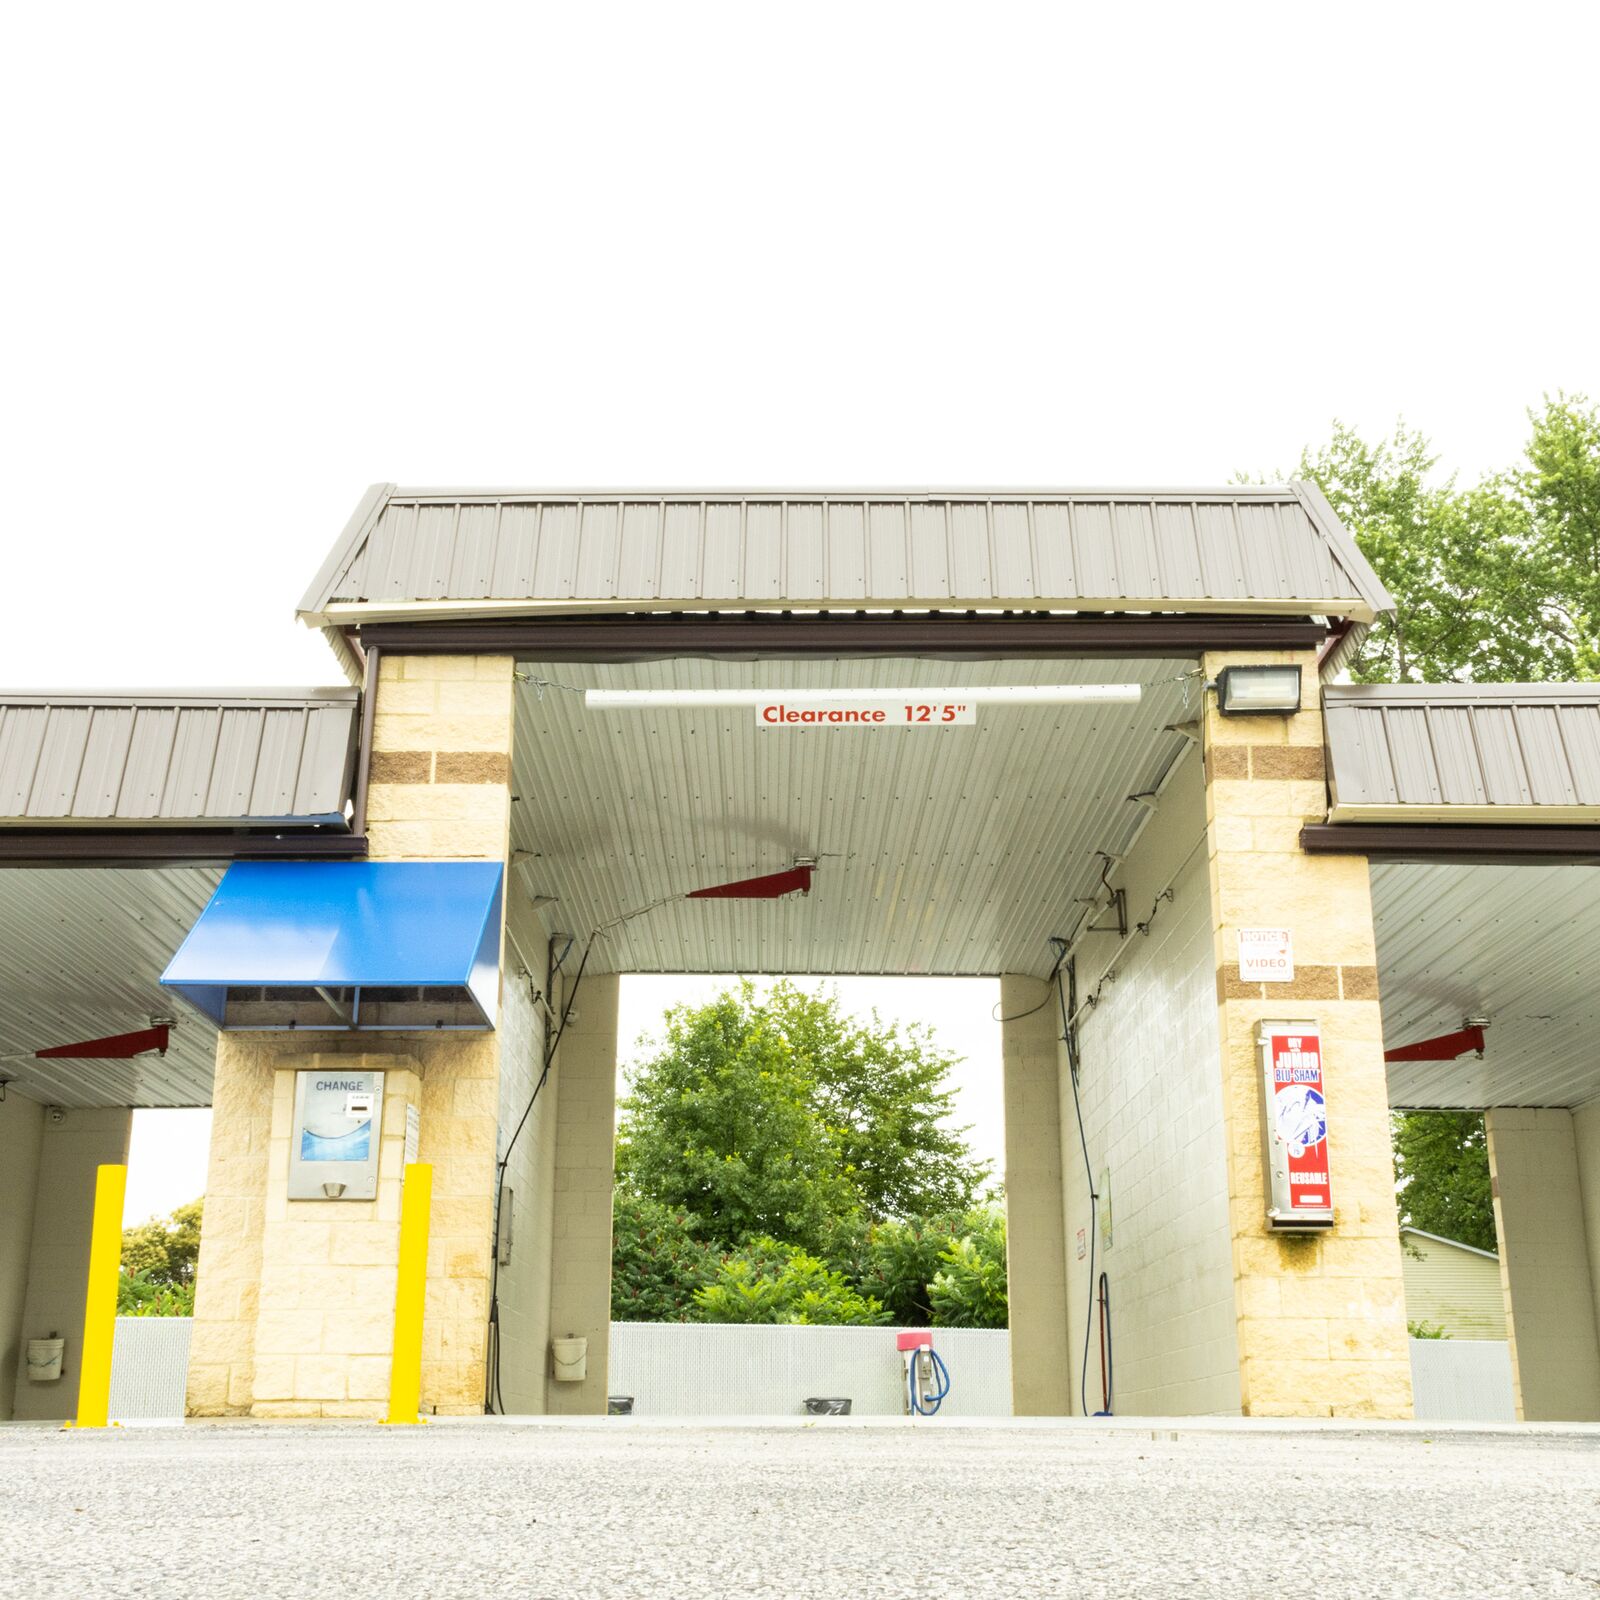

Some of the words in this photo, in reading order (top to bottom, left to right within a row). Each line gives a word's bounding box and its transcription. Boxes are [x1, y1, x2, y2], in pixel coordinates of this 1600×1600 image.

[762, 704, 887, 723] Clearance
[1246, 958, 1287, 968] VIDEO
[1275, 1051, 1319, 1069] JUMBO
[315, 1081, 364, 1092] CHANGE
[1290, 1171, 1328, 1185] REUSABLE
